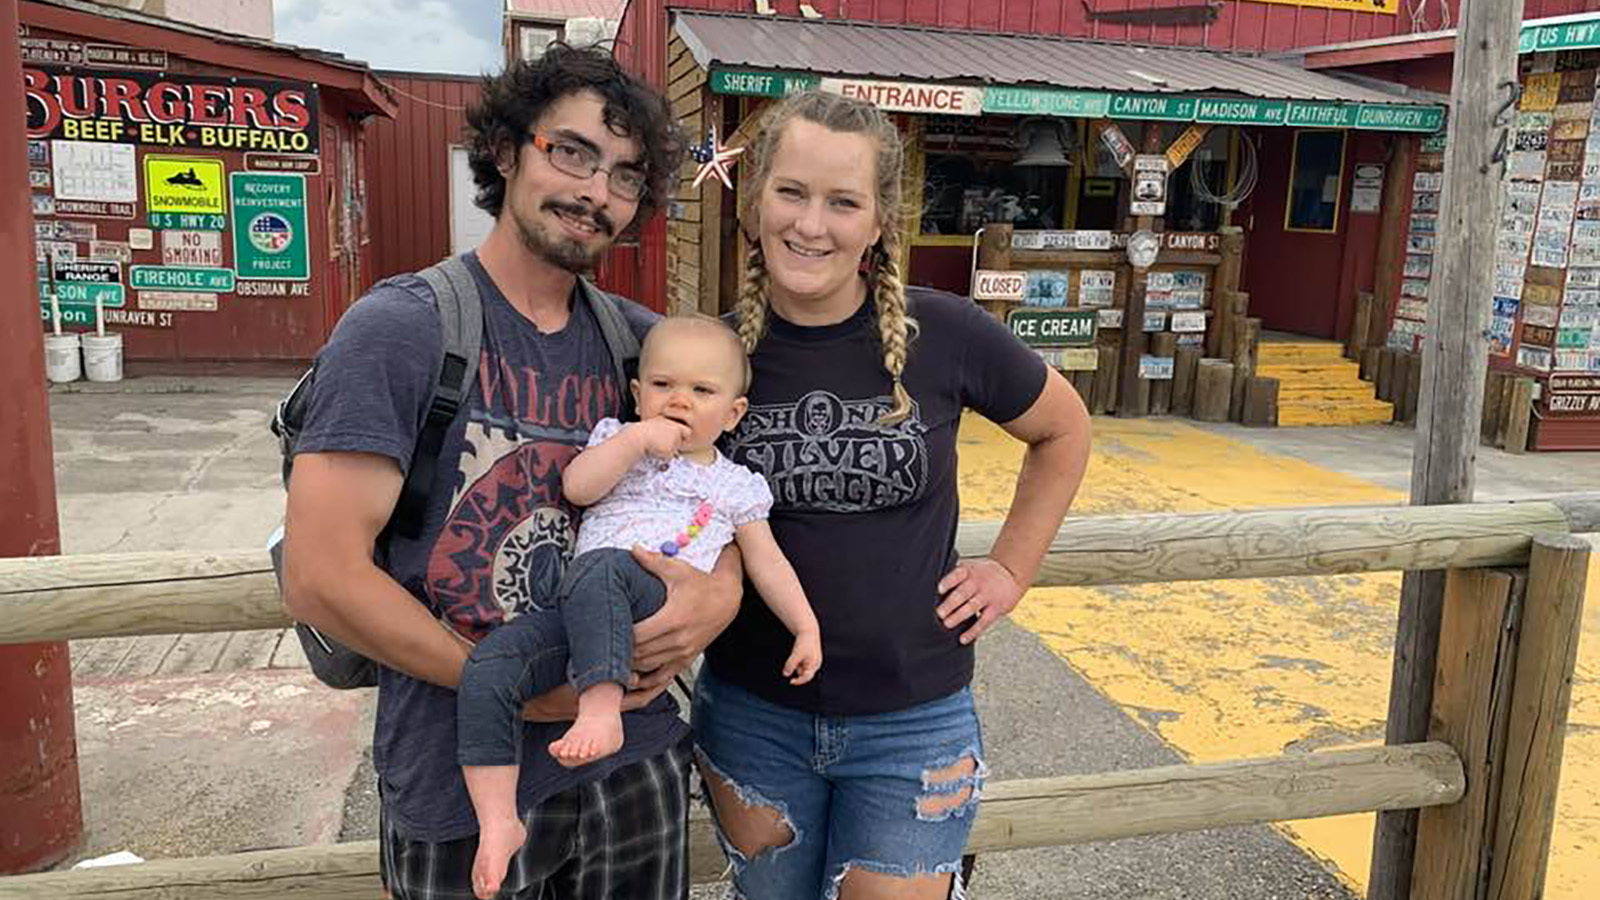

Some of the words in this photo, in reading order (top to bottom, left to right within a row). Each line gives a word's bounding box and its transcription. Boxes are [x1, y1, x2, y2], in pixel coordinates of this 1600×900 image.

[1540, 27, 1559, 45] US
[1565, 24, 1598, 44] HWY
[723, 73, 774, 93] SHERIFF
[784, 78, 809, 96] WAY
[26, 71, 310, 138] BURGERS
[842, 84, 964, 111] ENTRANCE
[987, 88, 1081, 111] YELLOWSTONE
[1114, 96, 1168, 114] CANYON
[1177, 102, 1190, 114] ST
[1200, 102, 1257, 118] MADISON
[1265, 109, 1283, 121] AVE
[1291, 108, 1349, 124] FAITHFUL
[1361, 109, 1421, 125] DUNRAVEN
[1427, 115, 1438, 127] ST
[63, 120, 124, 141] BEEF
[140, 124, 186, 145] ELK
[201, 128, 309, 151] BUFFALO
[244, 183, 291, 193] RECOVERY
[55, 200, 107, 214] SNOWMOBILE
[110, 203, 133, 216] TRAIL
[152, 195, 220, 208] SNOWMOBILE
[235, 198, 304, 207] REINVESTMENT
[152, 214, 160, 227] U
[164, 214, 173, 227] S
[180, 214, 208, 228] HWY
[210, 215, 225, 228] 20
[182, 233, 200, 246] NO
[1168, 234, 1206, 249] CANYON
[165, 247, 221, 264] SMOKING
[56, 261, 117, 273] SHERIFF'S
[252, 260, 292, 270] PROJECT
[65, 272, 110, 281] RANGE
[134, 270, 204, 286] FIREHOLE
[209, 276, 228, 287] AVE
[237, 282, 287, 296] OBSIDIAN
[290, 283, 310, 296] AVE
[980, 277, 1022, 294] CLOSED
[104, 310, 156, 326] UNRAVEN
[160, 313, 173, 327] ST
[1013, 319, 1037, 336] ICE
[1041, 318, 1092, 336] CREAM
[1550, 395, 1587, 411] GRIZZLY
[733, 437, 918, 492] SILVER
